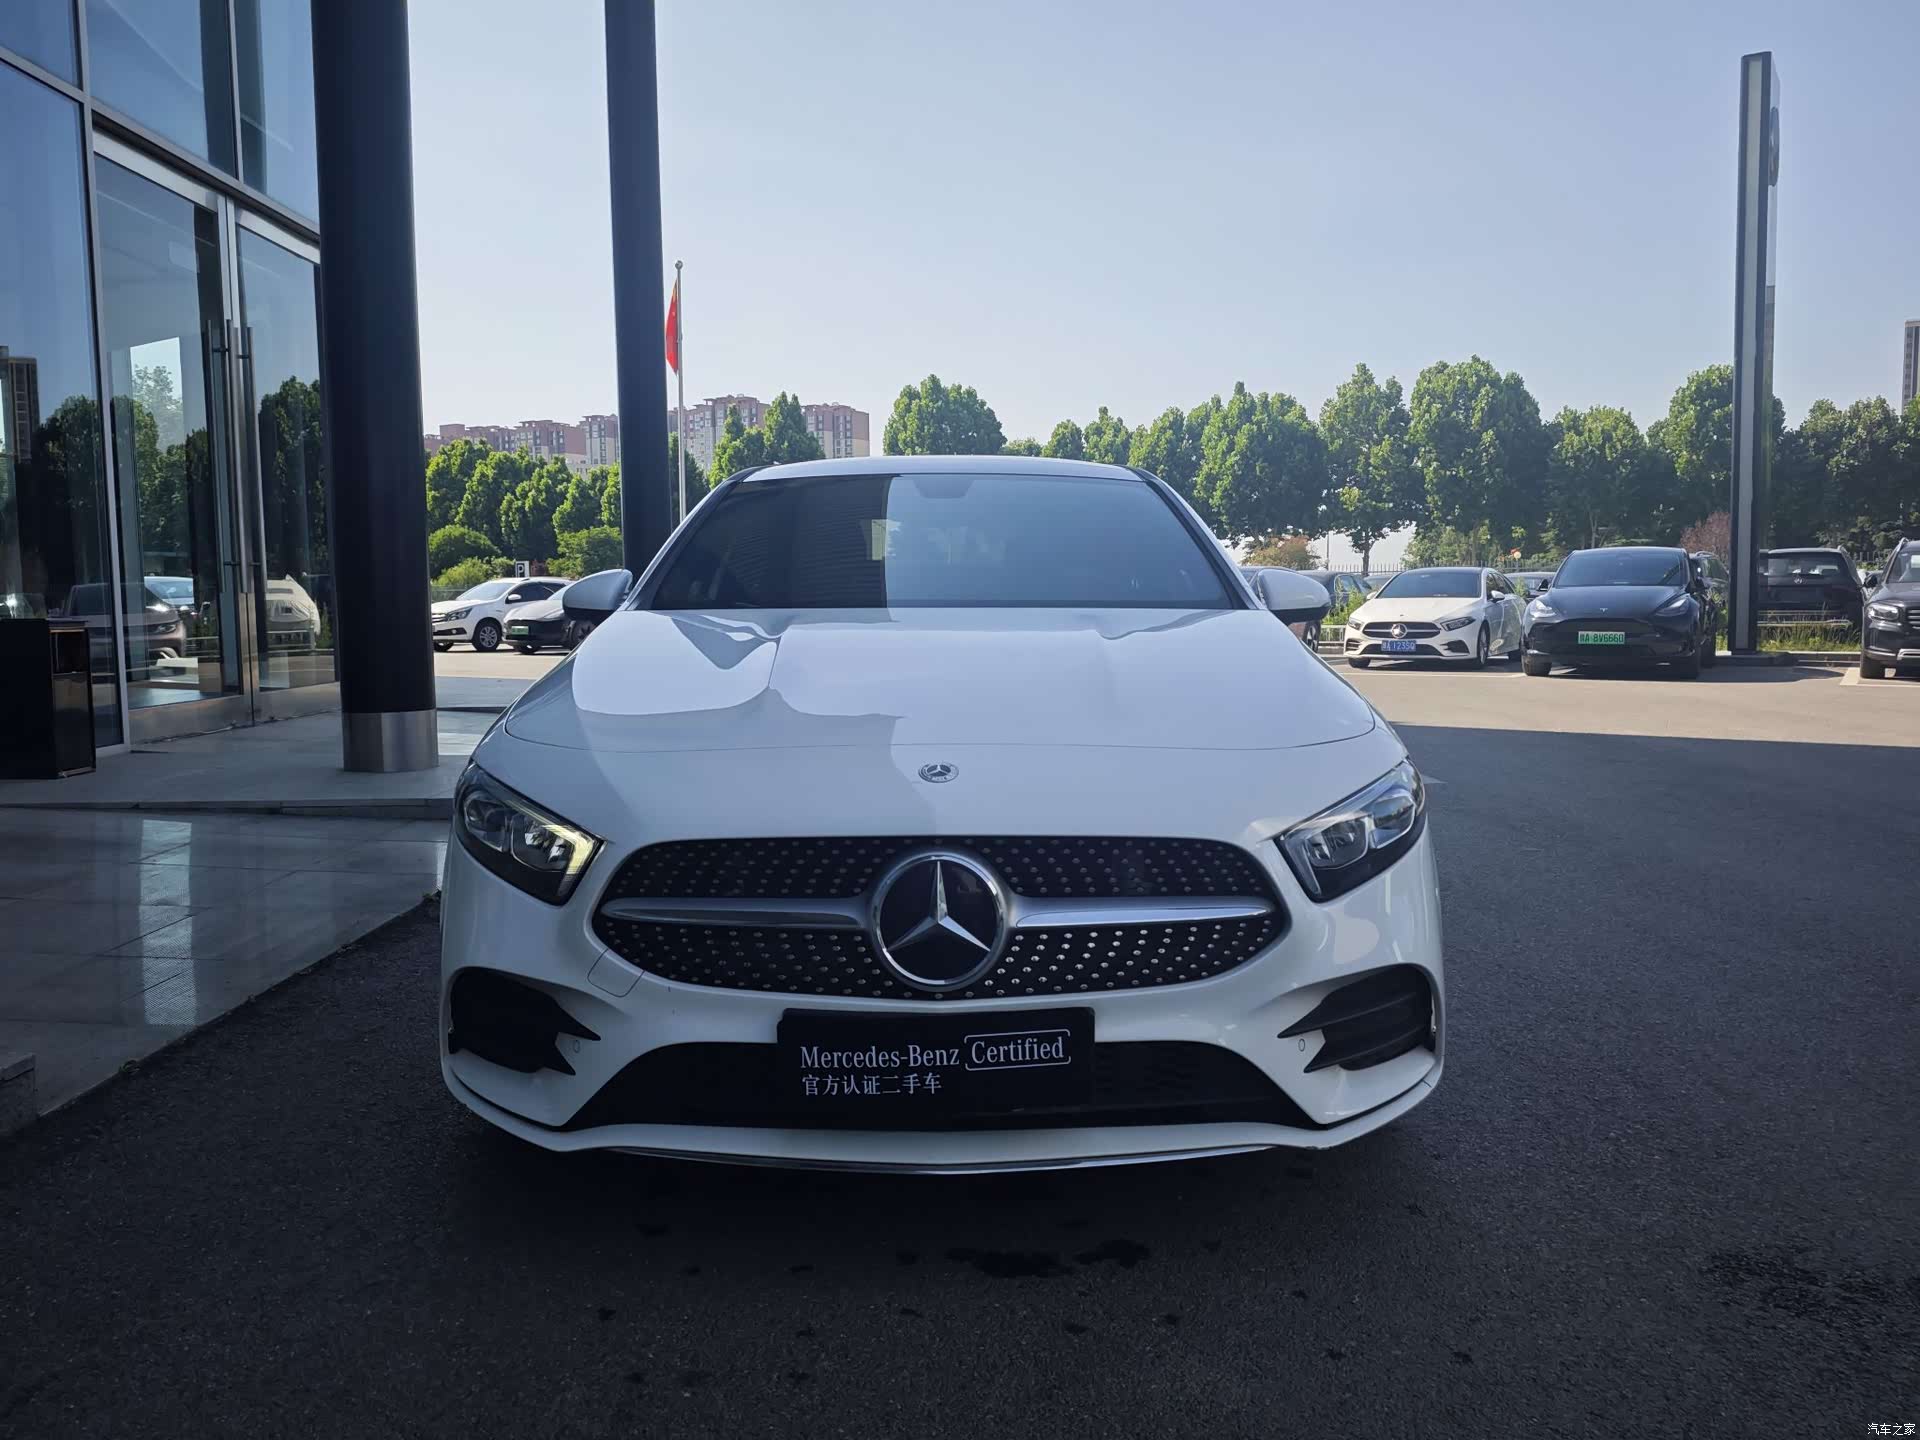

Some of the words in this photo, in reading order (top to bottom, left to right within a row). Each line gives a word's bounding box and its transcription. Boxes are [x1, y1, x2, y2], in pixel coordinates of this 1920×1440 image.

[800, 1044, 960, 1068] Mercedes-Benz
[971, 1036, 1064, 1064] Certified
[802, 1072, 942, 1096] 官方认证二手车
